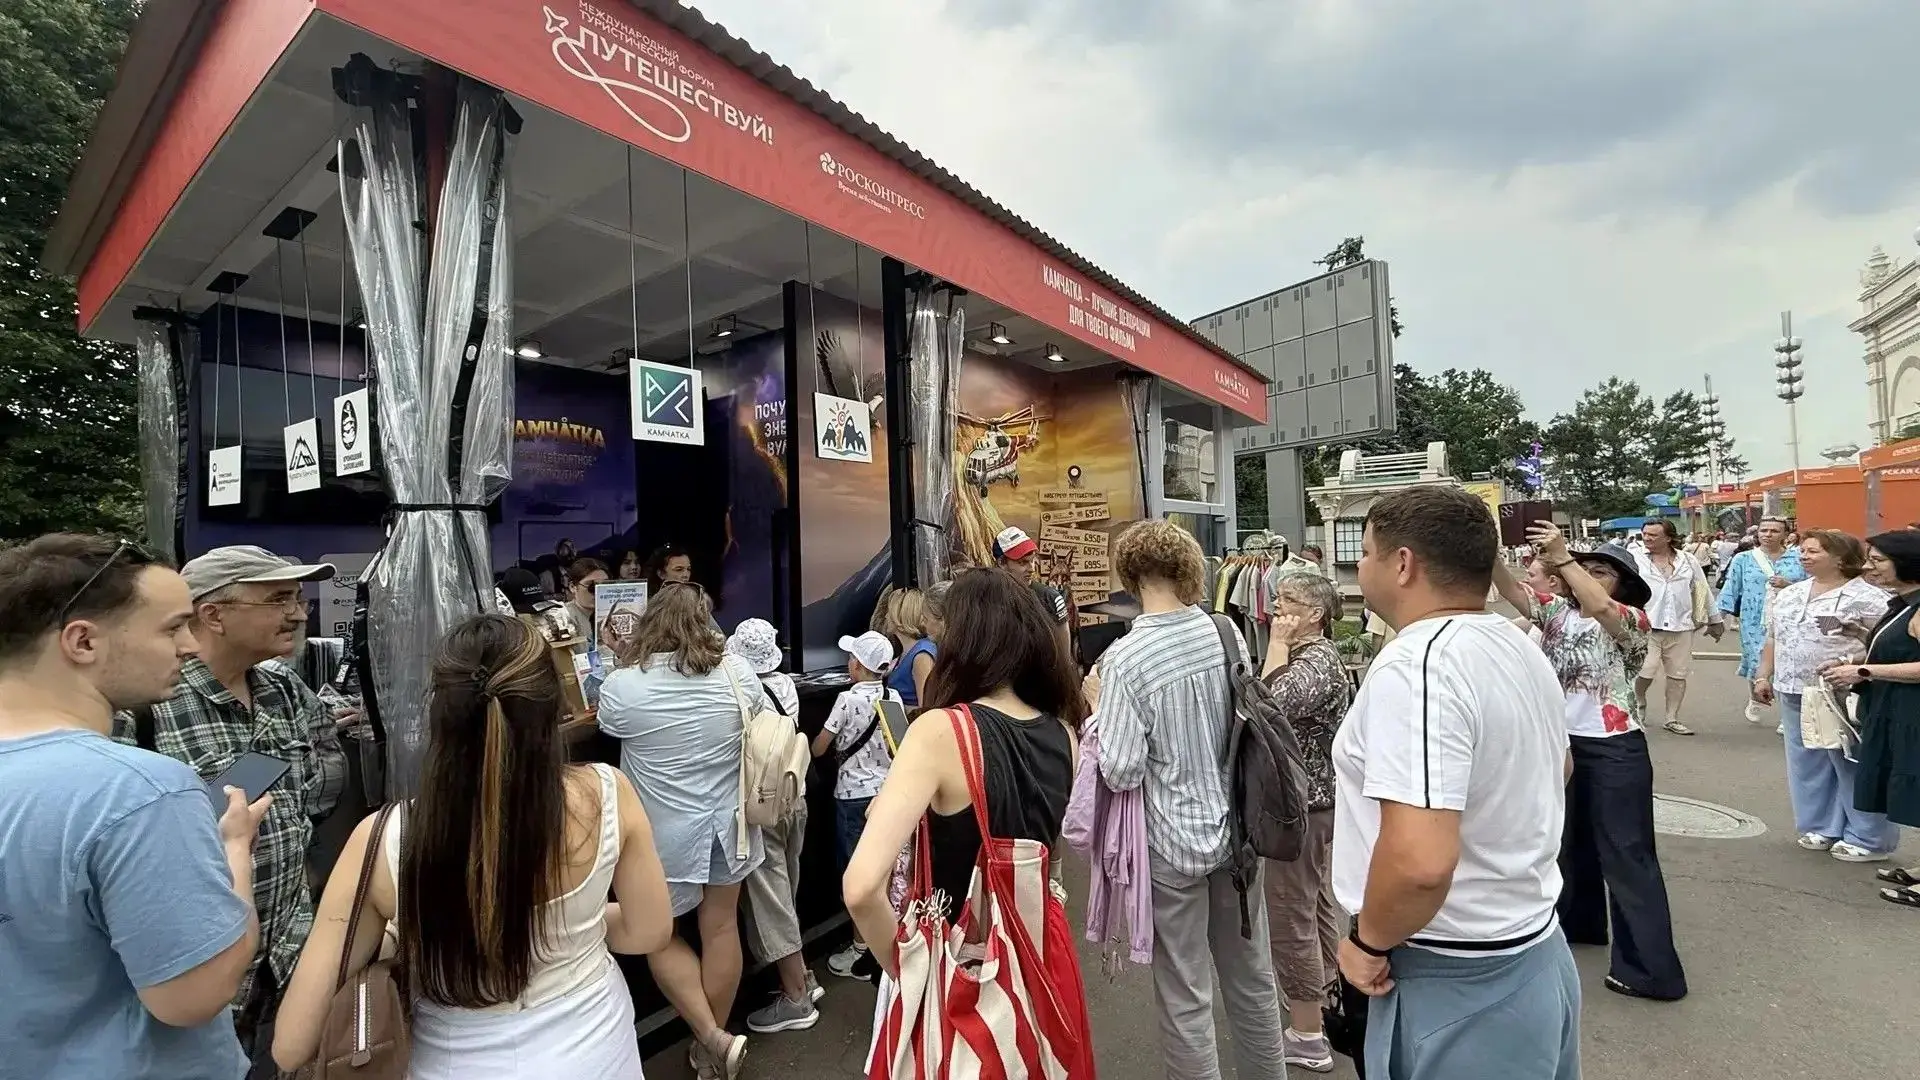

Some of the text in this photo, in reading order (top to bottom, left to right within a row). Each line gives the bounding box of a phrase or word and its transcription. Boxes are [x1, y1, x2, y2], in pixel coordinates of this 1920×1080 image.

[579, 0, 680, 62] МЕЖДУНАРОДНЫЙ
[579, 8, 716, 91] ТУРИСТИЧЕСКИЙ ФОРУМ
[577, 25, 775, 146] ПУТЕШЕСТВУЙ!
[838, 162, 925, 220] РОСКОНГРЕСС
[1043, 263, 1084, 304] КАМЧАТКА
[1091, 291, 1119, 322] ЛУЧШИЕ
[1119, 307, 1152, 339] ДЕКОРАЦИИ
[1069, 303, 1136, 353] ДЛЯ ТВОЕГО ФИЛЬМА
[1214, 369, 1251, 400] КАМЧАТКА
[755, 399, 787, 420] ПОЧУ
[514, 417, 607, 448] АМЧАТКА
[647, 428, 691, 439] КАМЧАТКА
[1085, 508, 1103, 519] 6975
[1083, 546, 1100, 556] 6975
[1084, 533, 1101, 543] 6950
[1084, 560, 1102, 570] 6995
